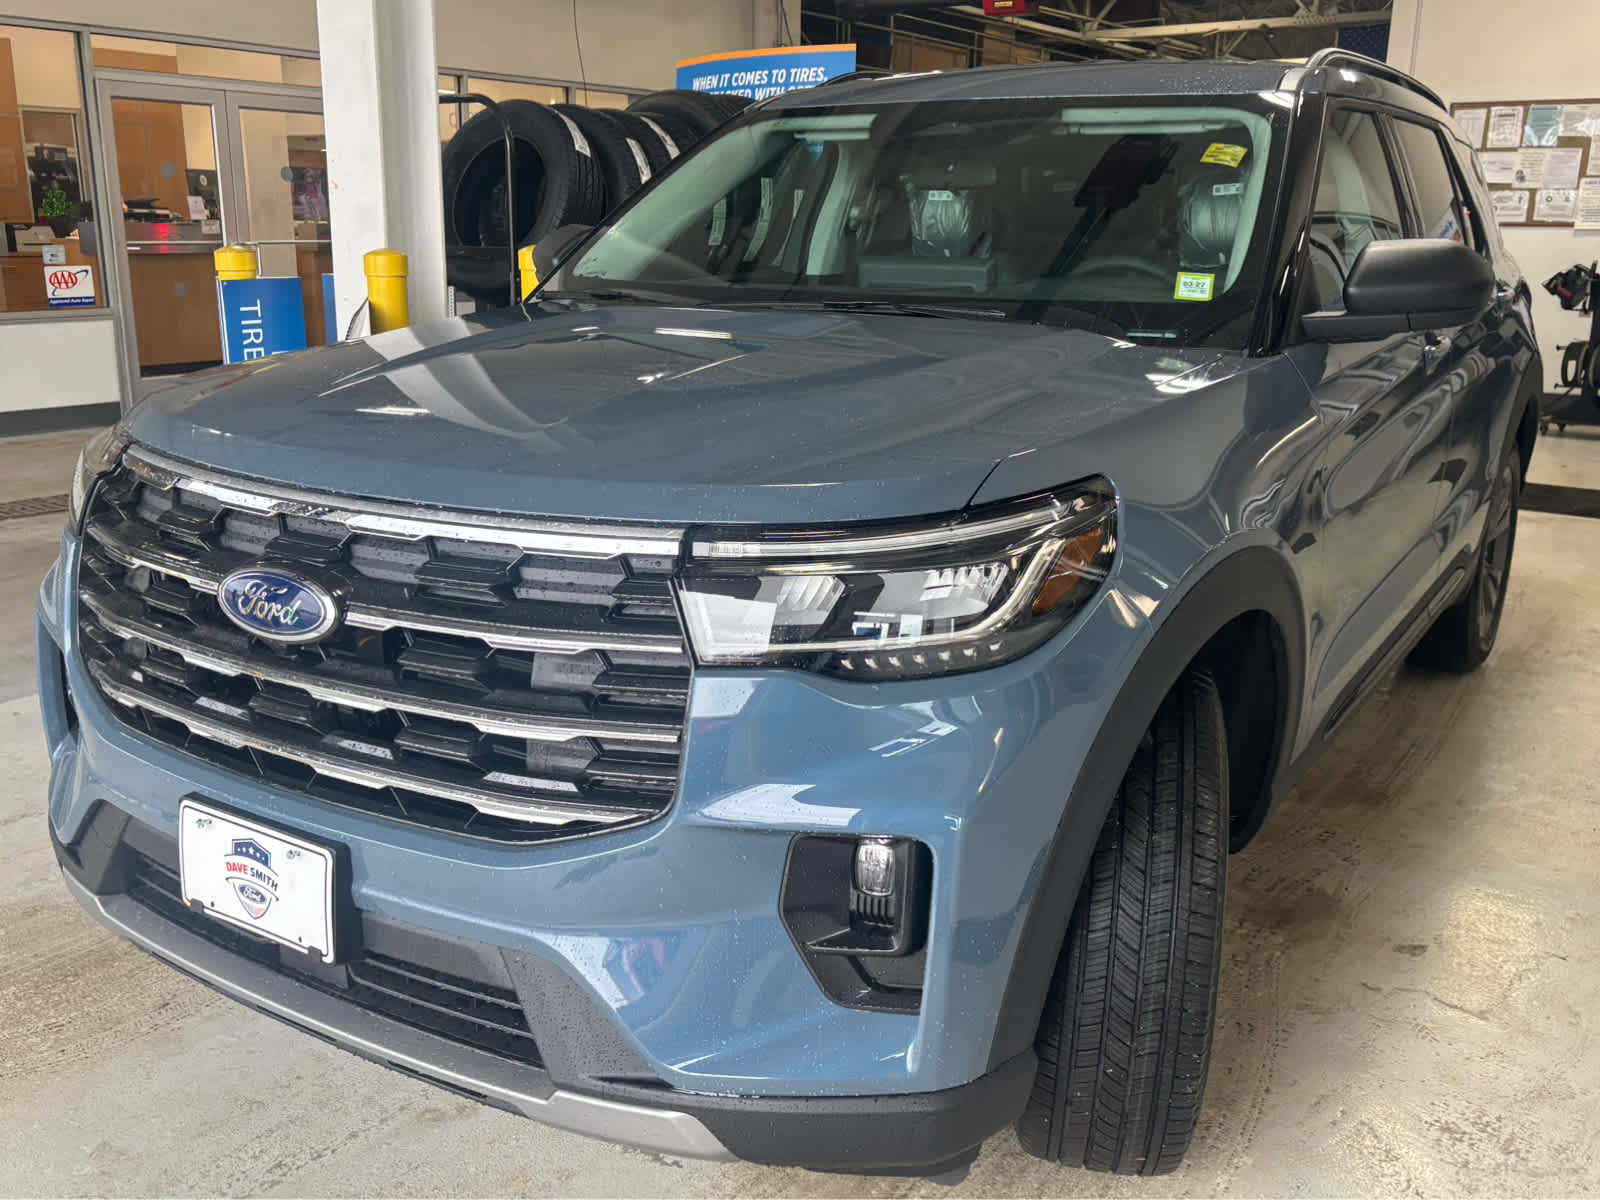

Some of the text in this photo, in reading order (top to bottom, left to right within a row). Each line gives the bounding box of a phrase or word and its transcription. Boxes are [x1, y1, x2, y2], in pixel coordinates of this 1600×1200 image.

[692, 67, 828, 91] WHEN IT COMES TO TIRES.
[754, 86, 785, 101] WITH
[50, 271, 77, 289] AAA
[238, 580, 302, 626] Ford
[225, 861, 278, 891] DAVE SMITH
